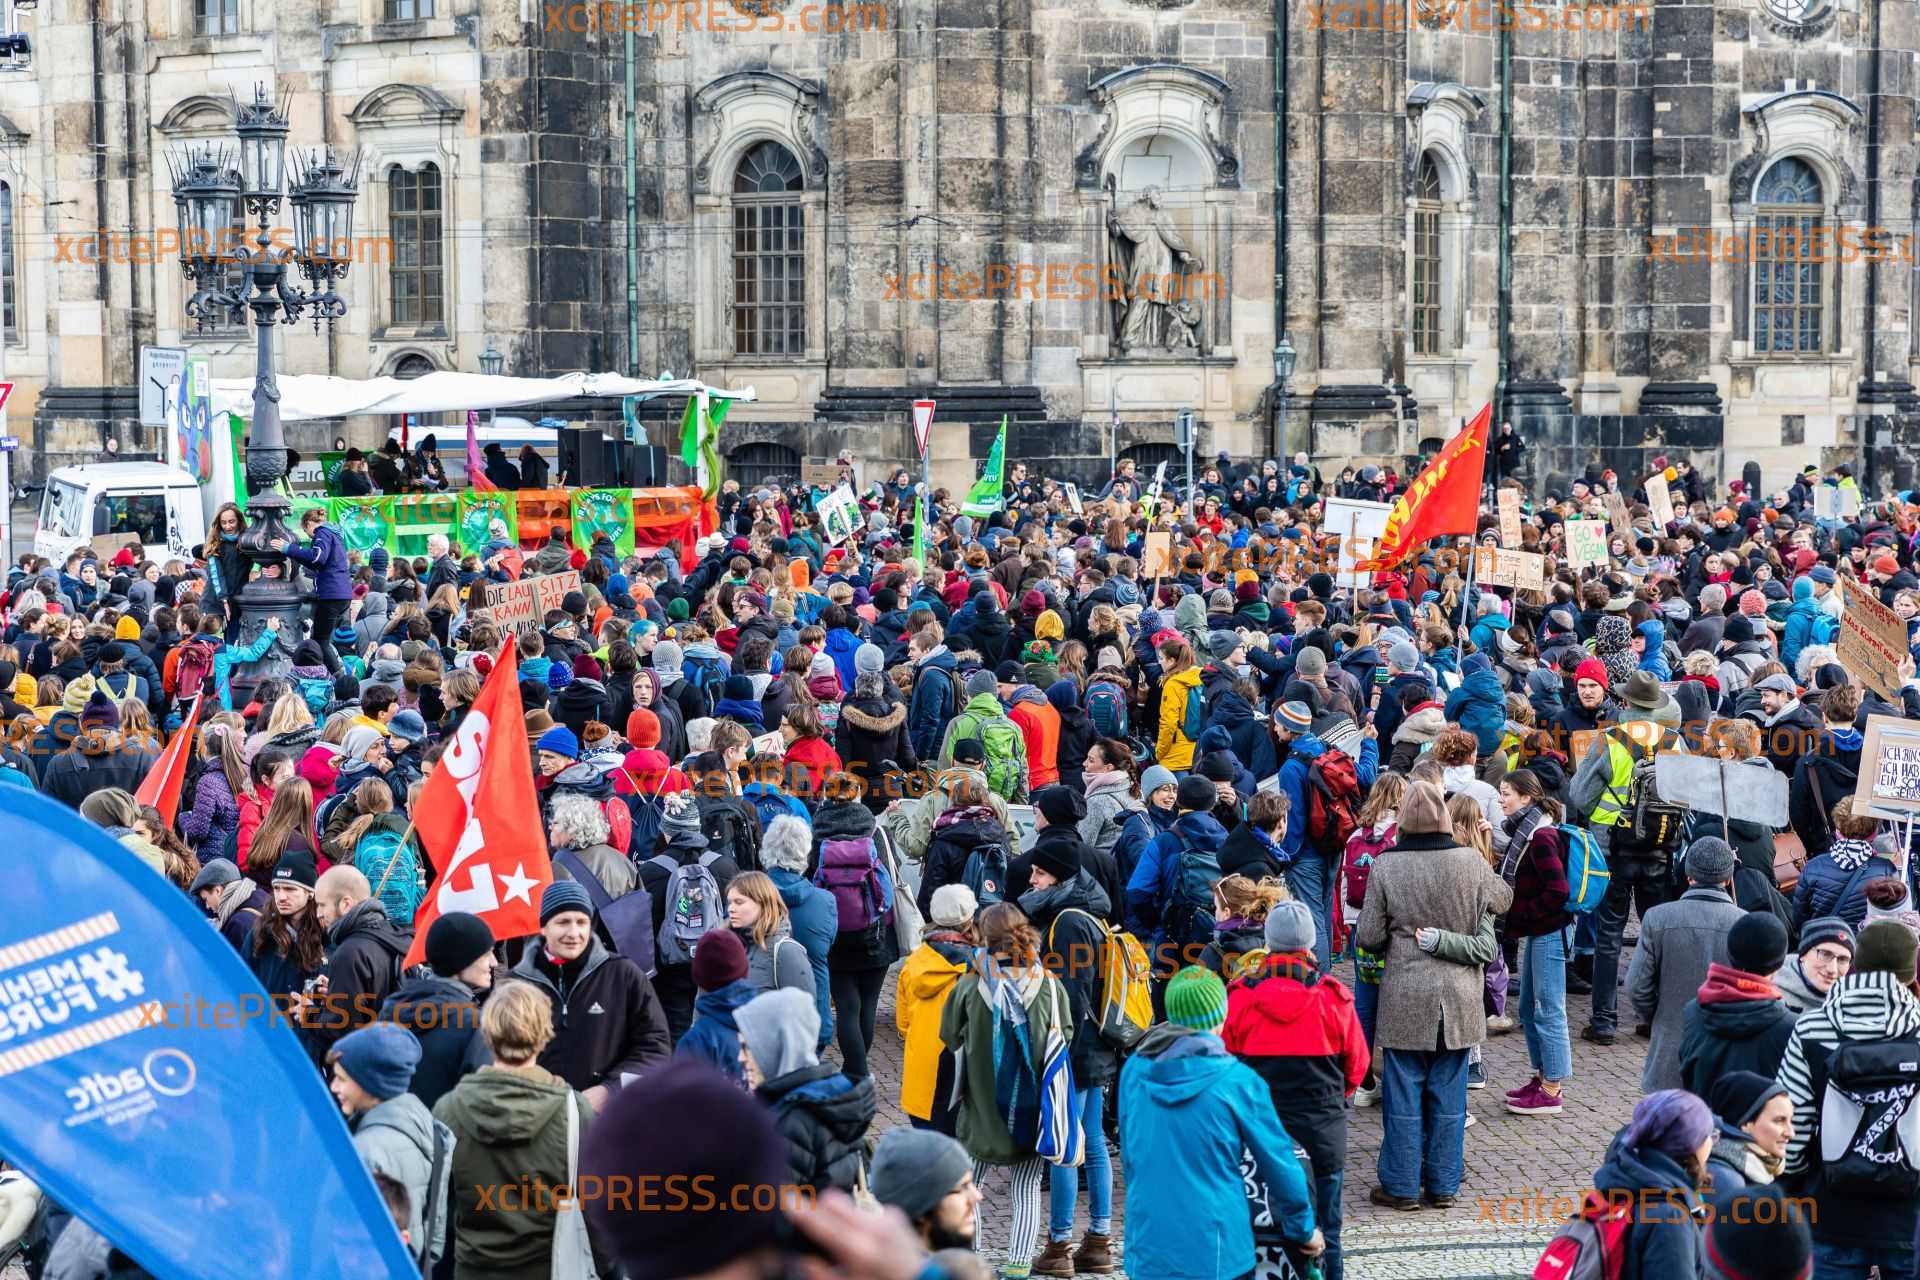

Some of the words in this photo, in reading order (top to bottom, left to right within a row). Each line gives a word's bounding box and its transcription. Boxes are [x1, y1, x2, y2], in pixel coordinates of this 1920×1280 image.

[488, 587, 505, 607] DIE
[494, 600, 531, 621] KANN
[1883, 745, 1900, 760] ICH
[1882, 761, 1898, 776] ICH
[1880, 775, 1897, 786] EIN
